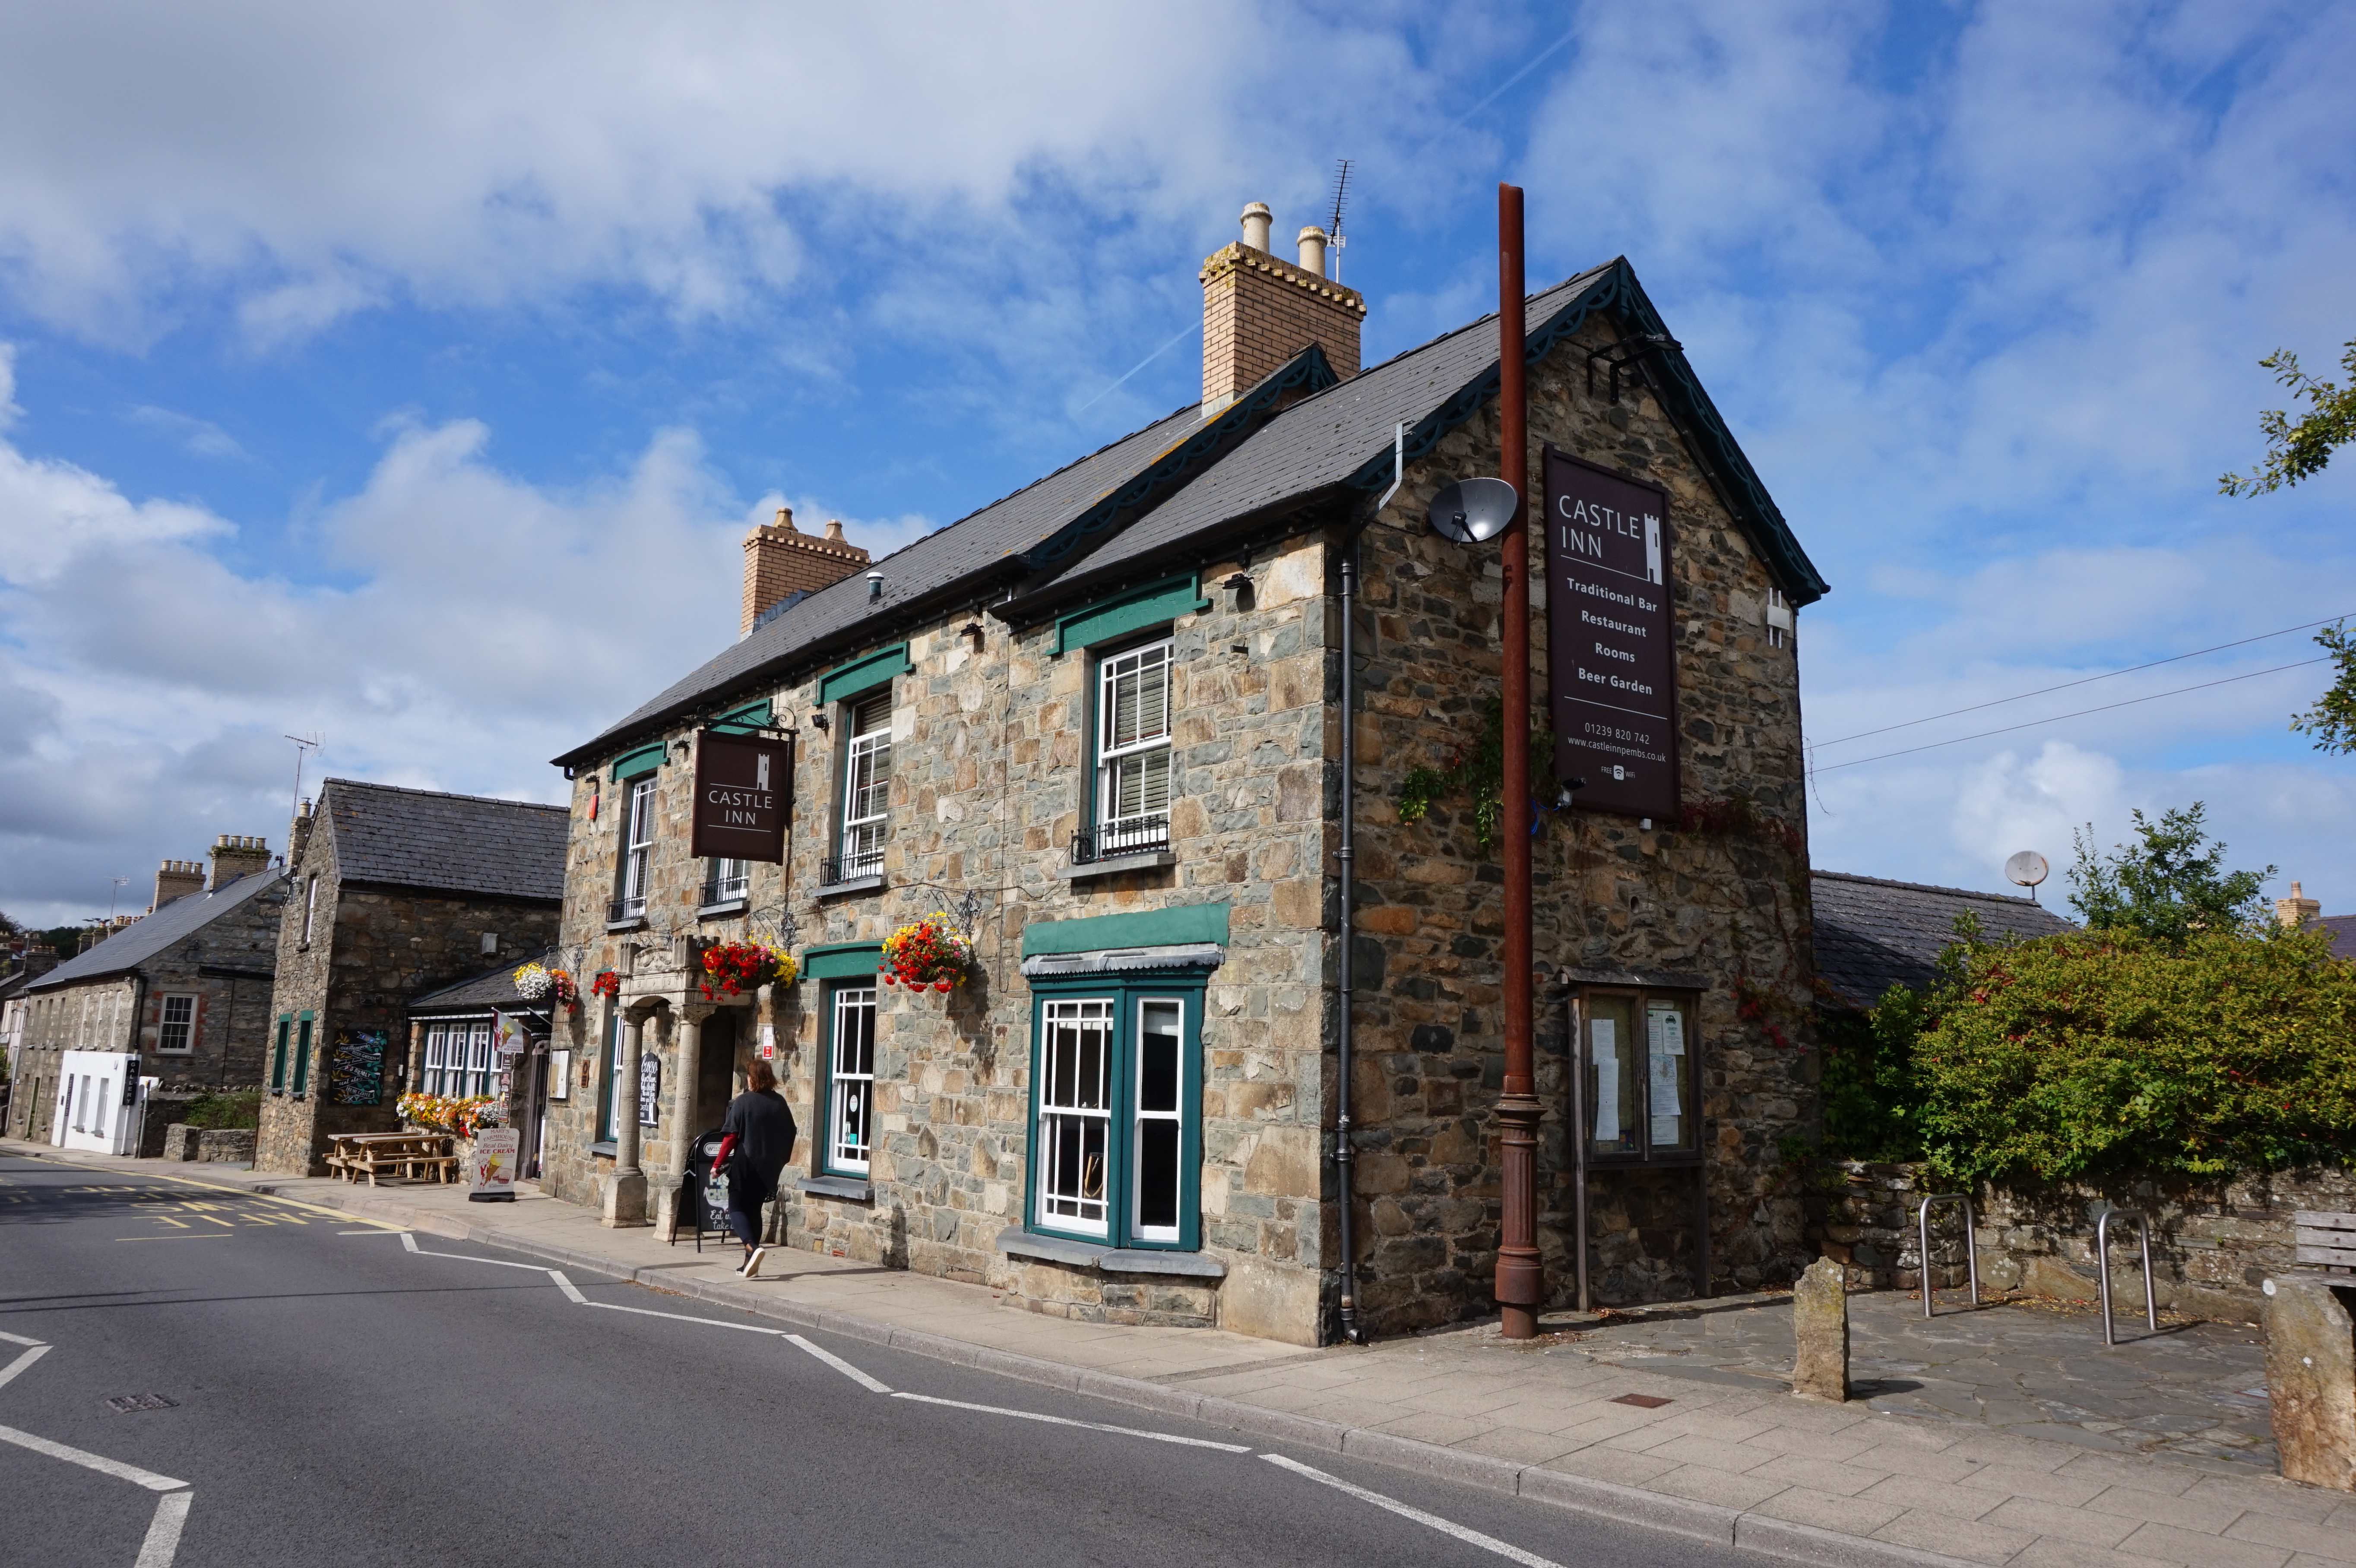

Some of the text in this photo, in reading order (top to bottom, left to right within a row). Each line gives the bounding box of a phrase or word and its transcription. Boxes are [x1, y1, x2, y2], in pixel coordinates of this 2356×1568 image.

[1559, 495, 1640, 539] CASTLE
[1562, 526, 1602, 558] INN
[1567, 577, 1657, 612] Traditional Bar
[1581, 610, 1647, 638] Restaurant
[1595, 642, 1635, 662] Rooms
[1578, 667, 1652, 695] Beer Garden
[1584, 722, 1650, 745] 01239 820 742
[1568, 737, 1666, 762] www.castleinnpembs.co.uk
[1601, 766, 1635, 779] FREE WiFi
[709, 790, 773, 809] CASTLE
[725, 809, 756, 825] INN
[127, 1062, 136, 1103] GALLERY
[709, 1173, 730, 1186] FIS
[707, 1189, 729, 1199] CHI
[710, 1209, 723, 1220] Eat
[712, 1220, 729, 1230] take
